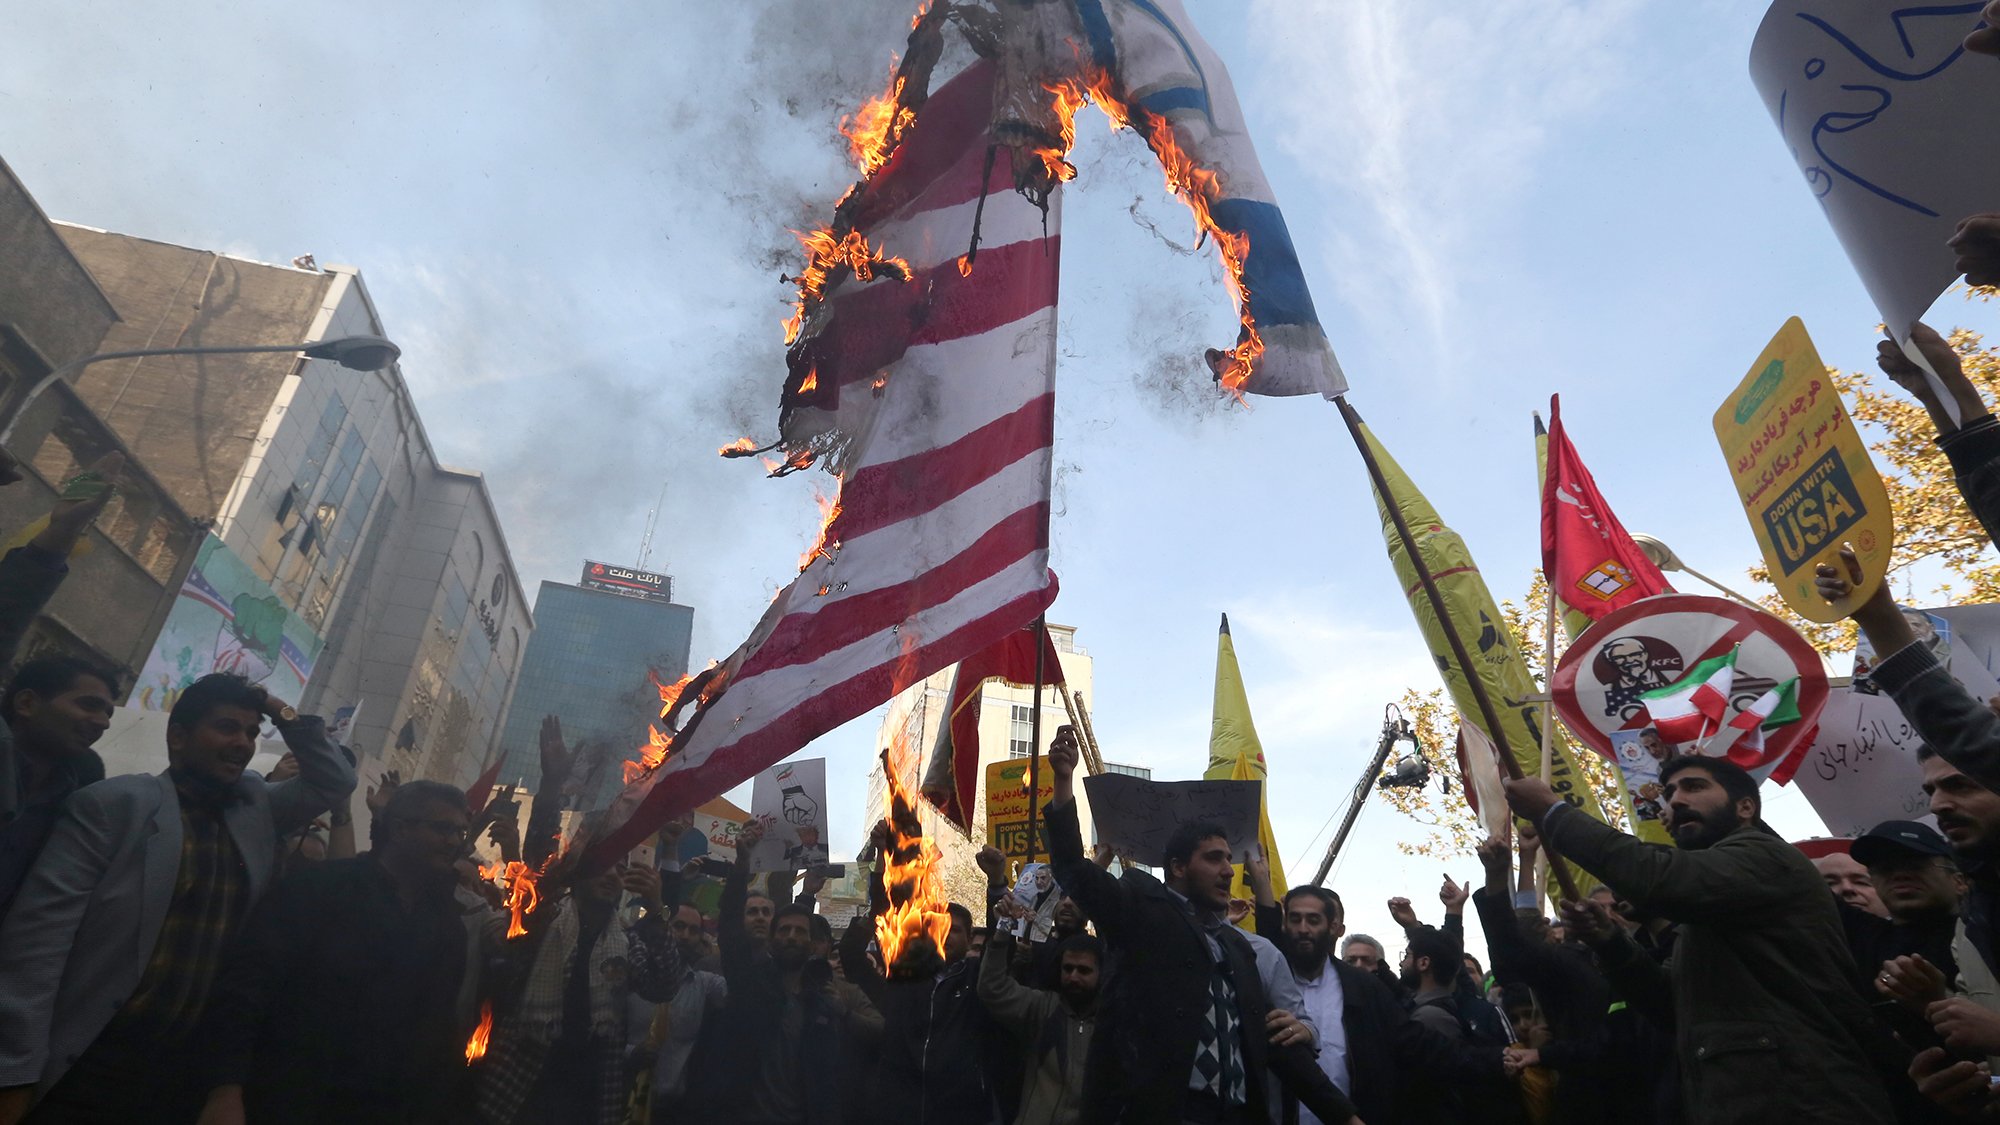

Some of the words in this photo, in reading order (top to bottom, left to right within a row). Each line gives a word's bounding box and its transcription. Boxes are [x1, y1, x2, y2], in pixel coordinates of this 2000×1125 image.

[1789, 395, 1807, 416] چه
[1808, 380, 1822, 408] هر
[1763, 407, 1789, 446] فریاد
[1738, 440, 1762, 474] دارید
[1772, 427, 1809, 477] آمریکا
[1769, 487, 1803, 525] DOWN
[1802, 457, 1836, 492] WITH
[1775, 479, 1856, 561] USA
[609, 567, 634, 580] ملت
[1651, 657, 1681, 666] KFC
[1000, 824, 1022, 832] DOWN
